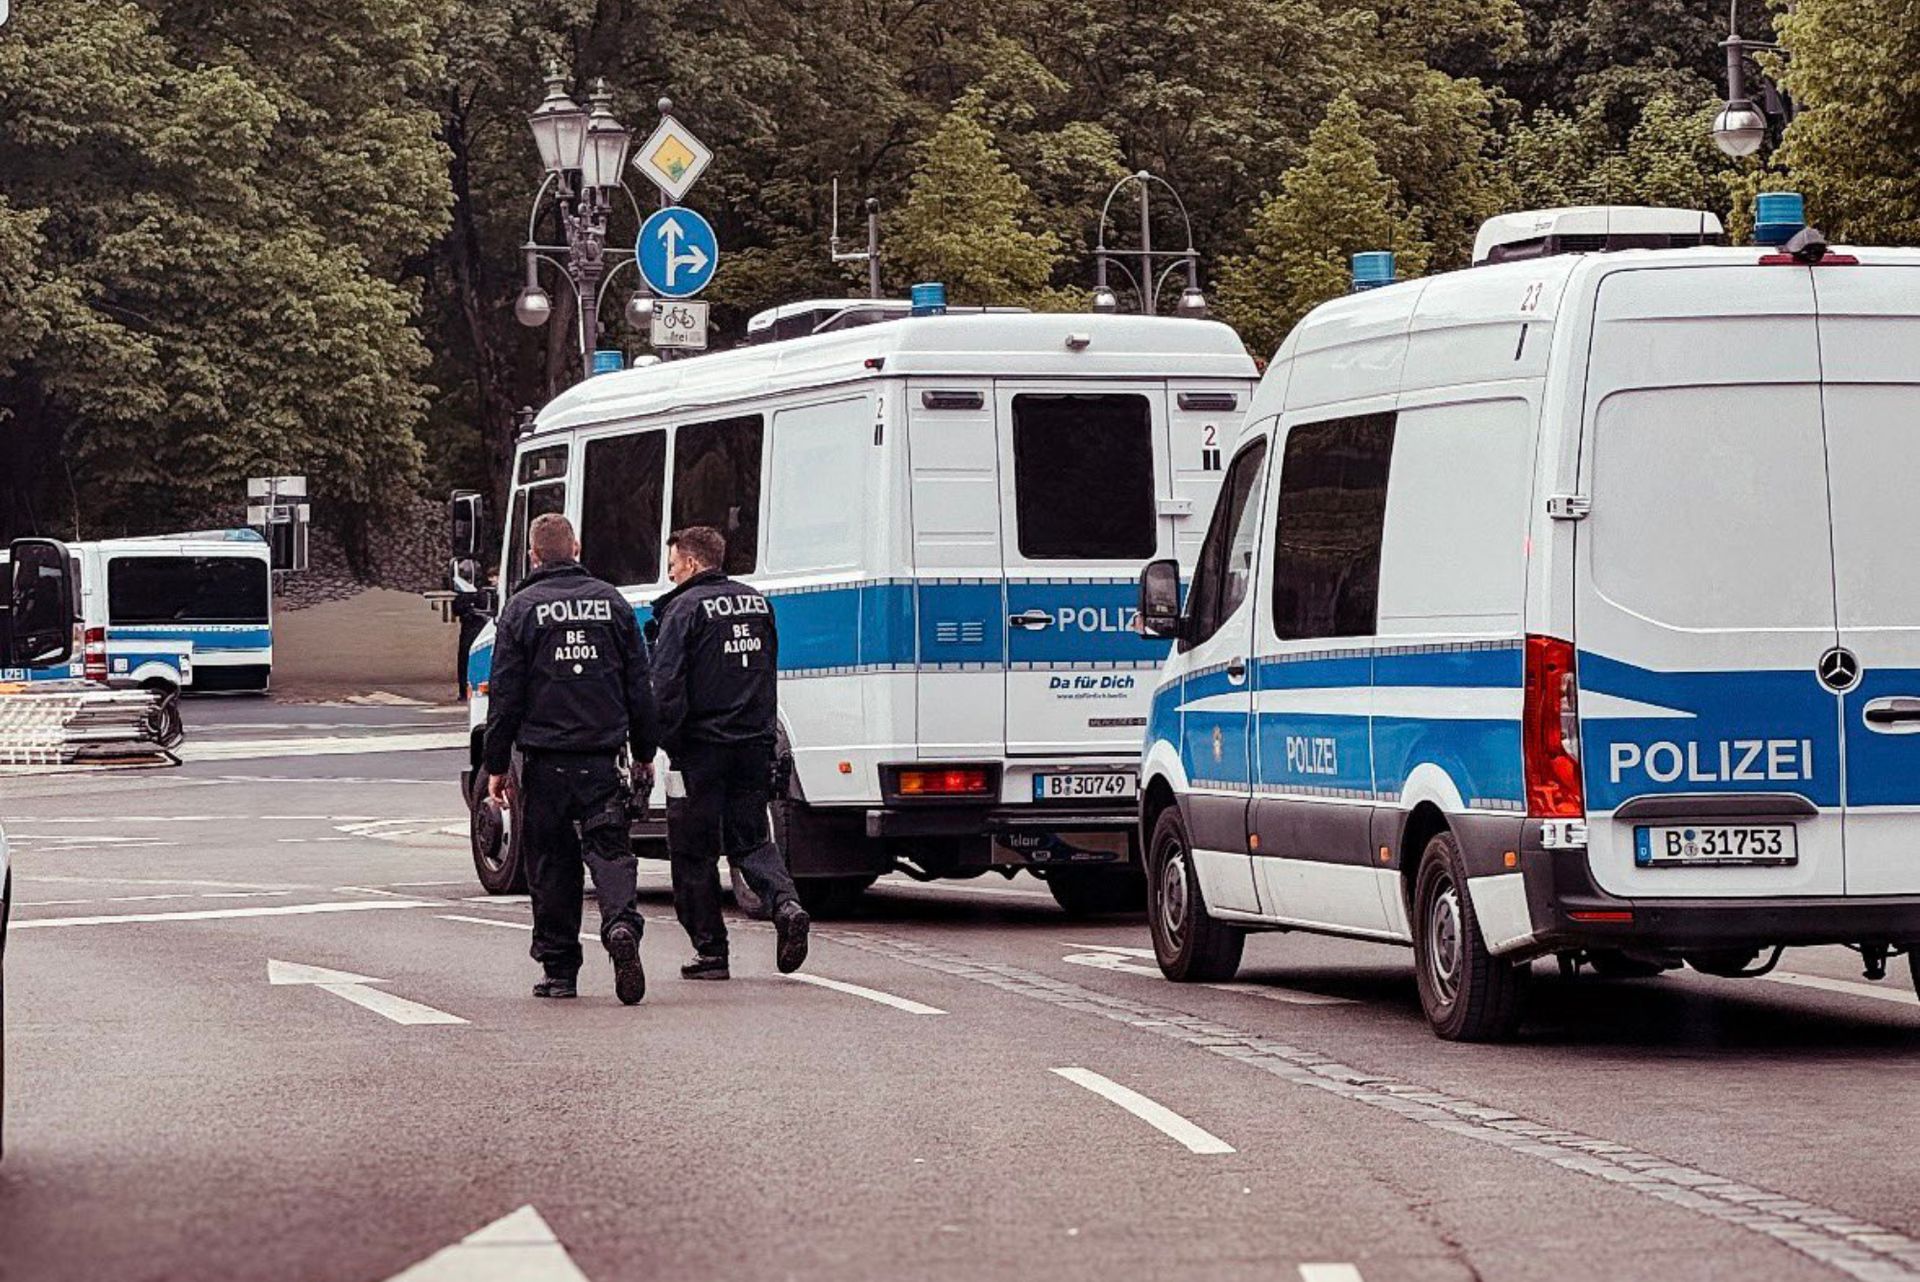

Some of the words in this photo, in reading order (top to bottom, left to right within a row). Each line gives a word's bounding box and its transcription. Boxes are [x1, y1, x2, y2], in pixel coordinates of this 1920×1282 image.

[1521, 282, 1543, 311] 23
[670, 331, 688, 342] frei
[1204, 424, 1216, 446] 2
[535, 599, 612, 625] POLIZEI
[702, 594, 769, 619] POLIZEI
[1058, 606, 1137, 632] POLIZ
[566, 630, 586, 645] BE
[732, 623, 751, 638] BE
[554, 645, 599, 661] A1001
[724, 638, 761, 654] A1000
[1049, 676, 1070, 689] Da
[1074, 675, 1098, 689] für
[1100, 674, 1135, 689] Dich
[1285, 735, 1338, 776] POLIZEI
[1609, 738, 1813, 784] POLIZEI
[1051, 777, 1062, 795] B
[1074, 775, 1126, 795] 30749
[1665, 830, 1683, 857] B
[1701, 828, 1783, 856] 31753
